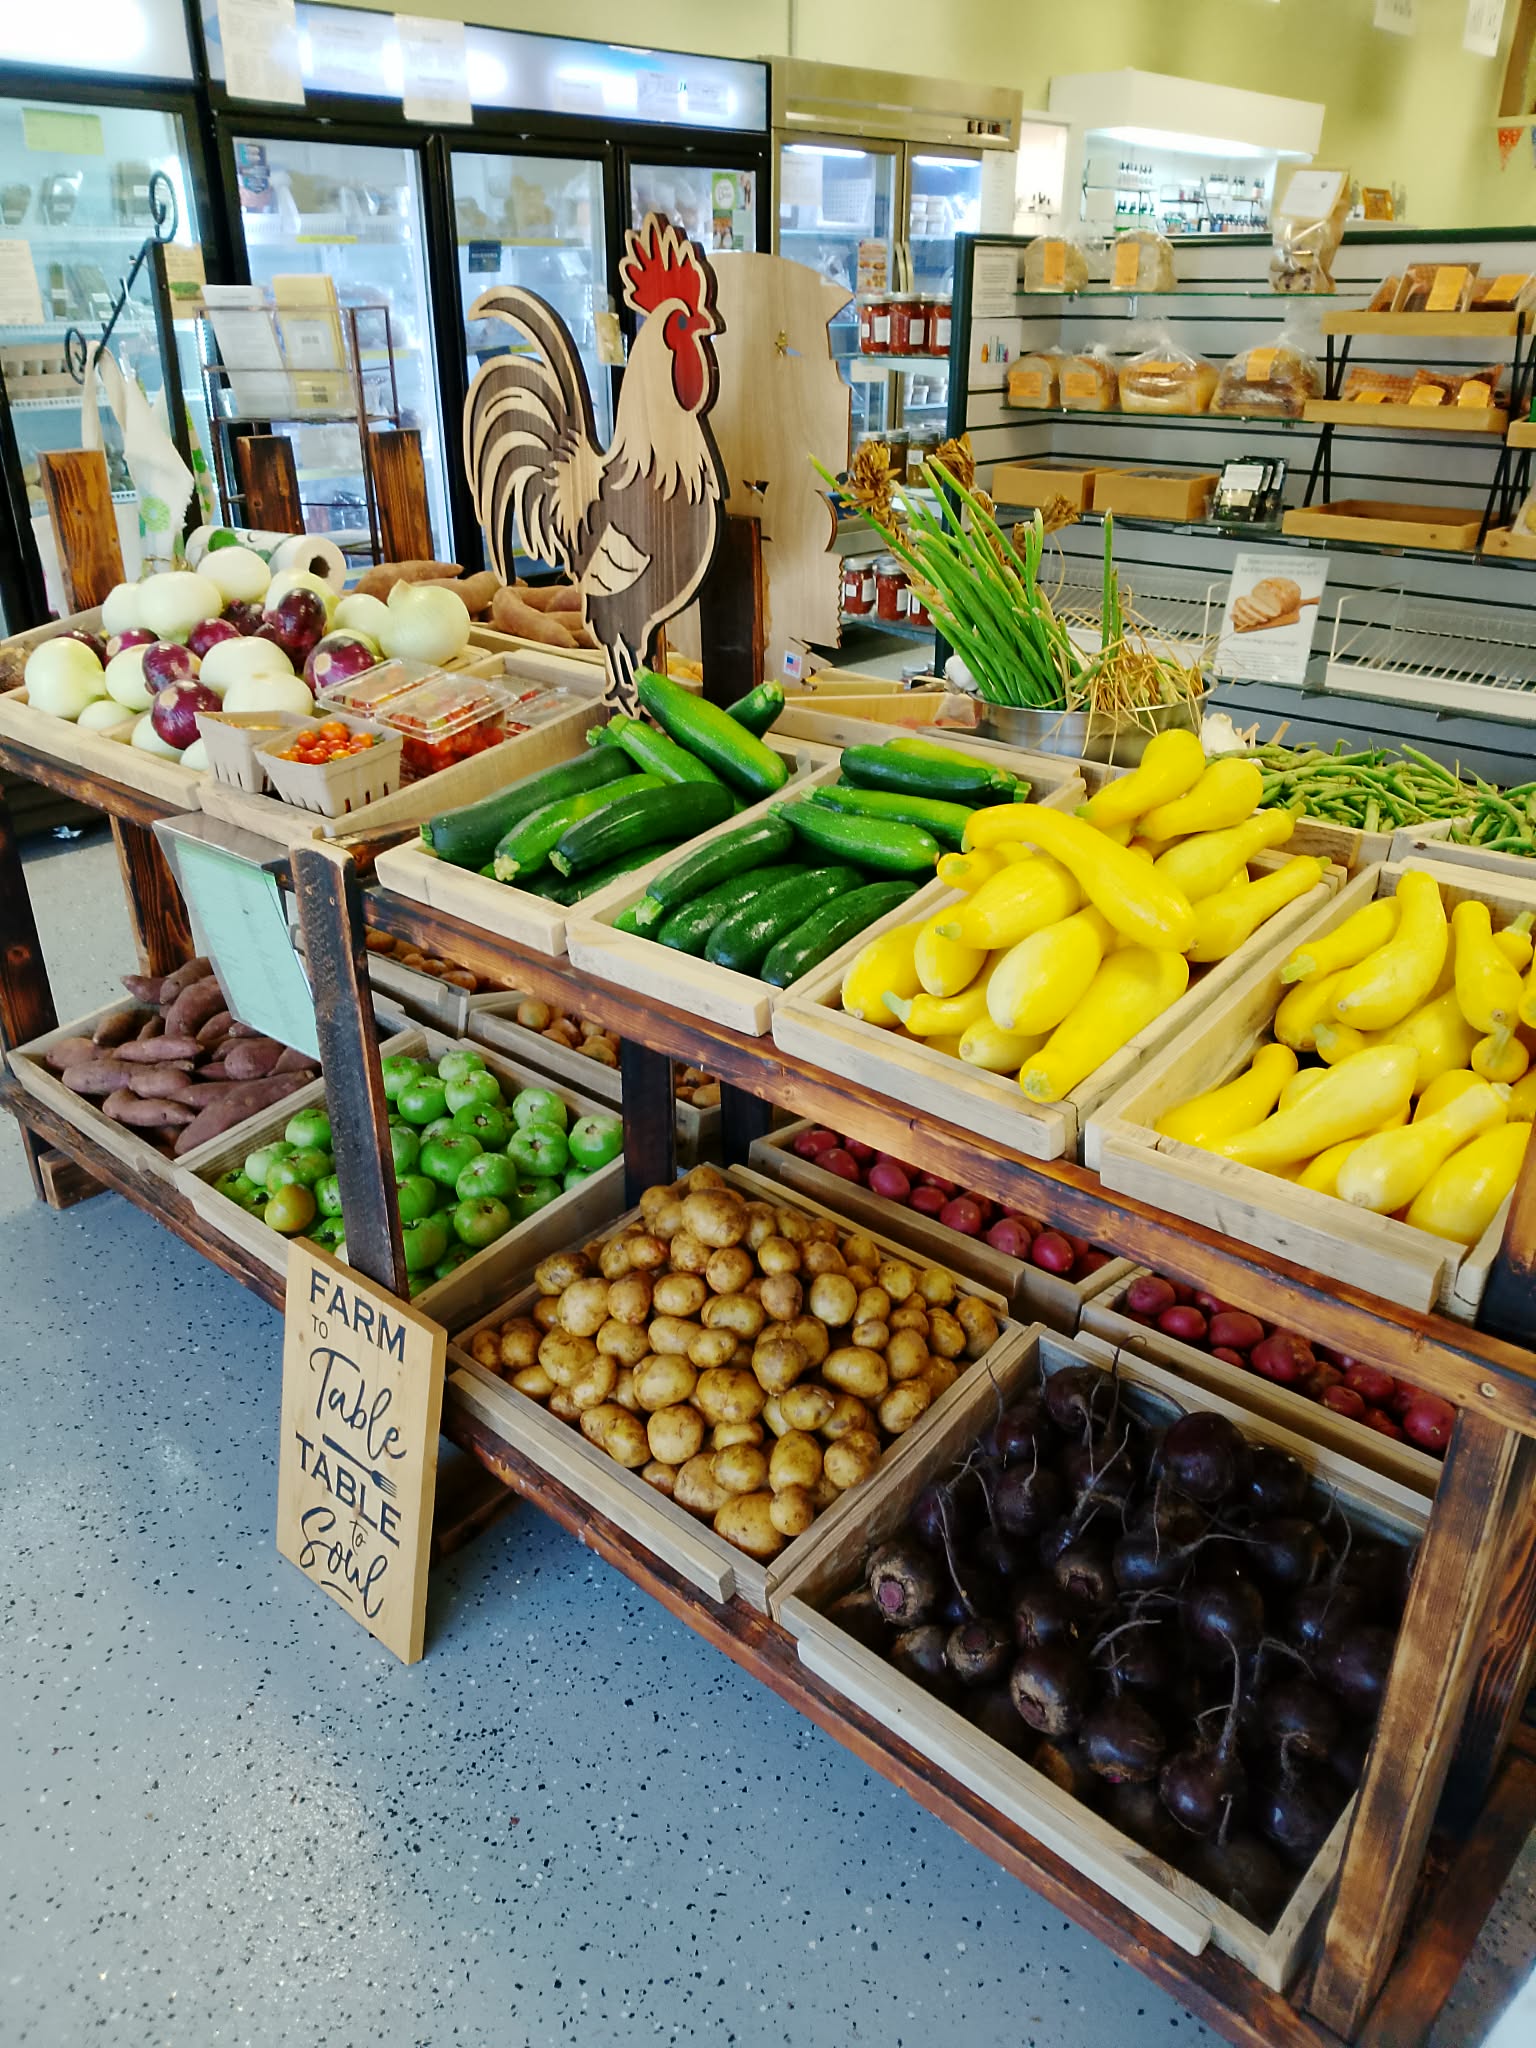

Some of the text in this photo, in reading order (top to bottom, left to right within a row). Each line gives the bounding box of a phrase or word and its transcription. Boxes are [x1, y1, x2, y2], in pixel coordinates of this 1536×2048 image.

[309, 1267, 407, 1364] FARM
[309, 1346, 407, 1460] Table
[295, 1429, 402, 1549] TABLE
[299, 1506, 389, 1618] Soul
